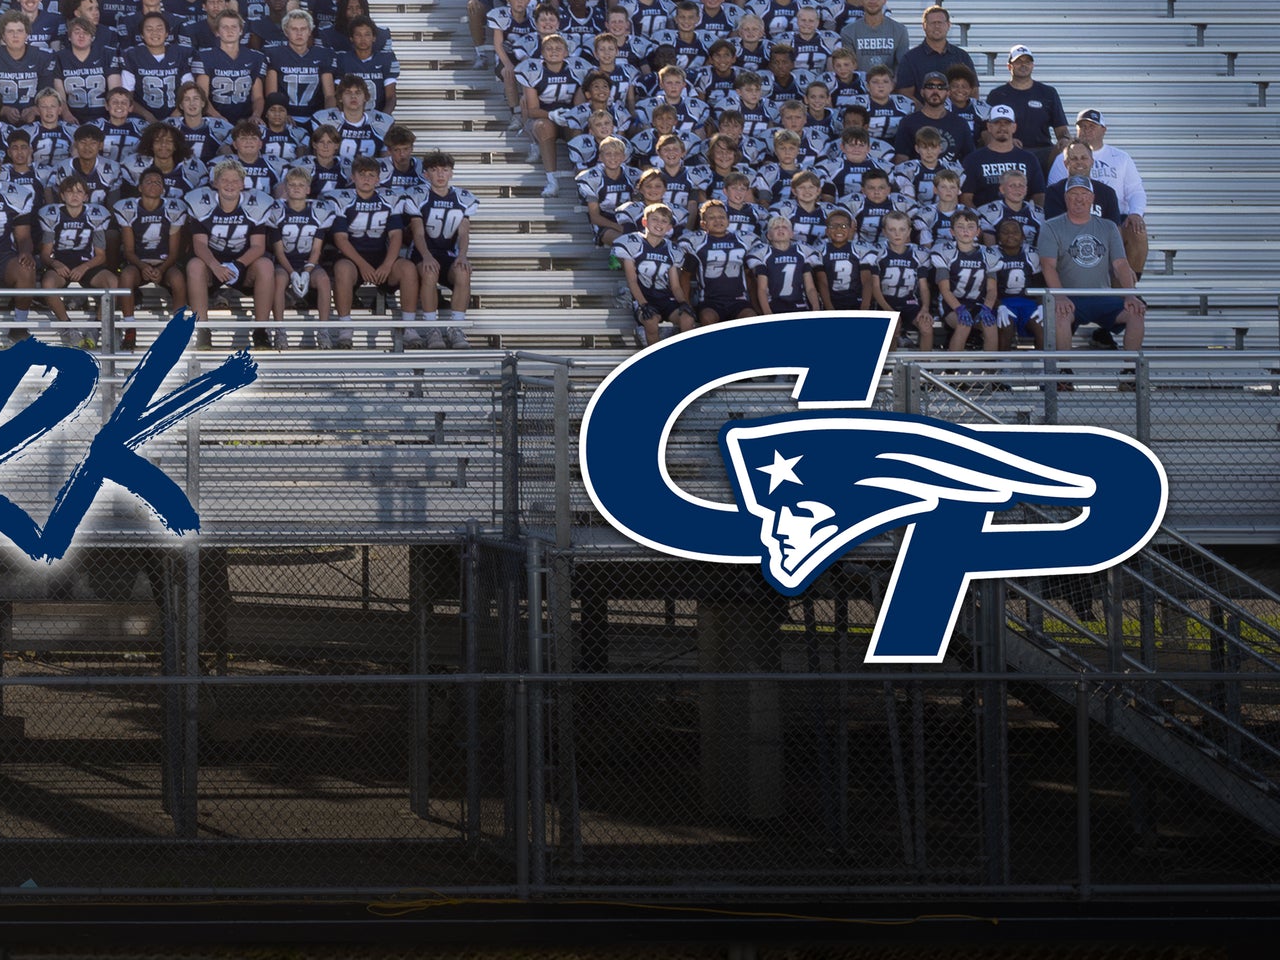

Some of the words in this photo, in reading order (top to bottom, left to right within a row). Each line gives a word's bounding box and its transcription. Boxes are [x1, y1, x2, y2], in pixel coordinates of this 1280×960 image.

[857, 38, 894, 49] REBELS
[281, 66, 306, 74] CHAMPLIN
[25, 72, 38, 80] PARK
[64, 76, 106, 107] 62
[284, 75, 320, 106] 17
[342, 129, 371, 138] REBELS
[981, 163, 1027, 176] REBELS
[392, 176, 418, 185] REBELS
[356, 200, 382, 210] REBELS
[434, 200, 453, 208] REBELS
[426, 209, 465, 239] 50
[142, 223, 161, 249] 4
[646, 253, 668, 261] REBELS
[775, 256, 797, 264] REBELS
[830, 252, 850, 260] REBELS
[890, 259, 911, 268] REBELS
[960, 260, 981, 268] REBELS
[832, 260, 852, 290] 3
[780, 264, 796, 296] 1
[954, 269, 984, 299] 11
